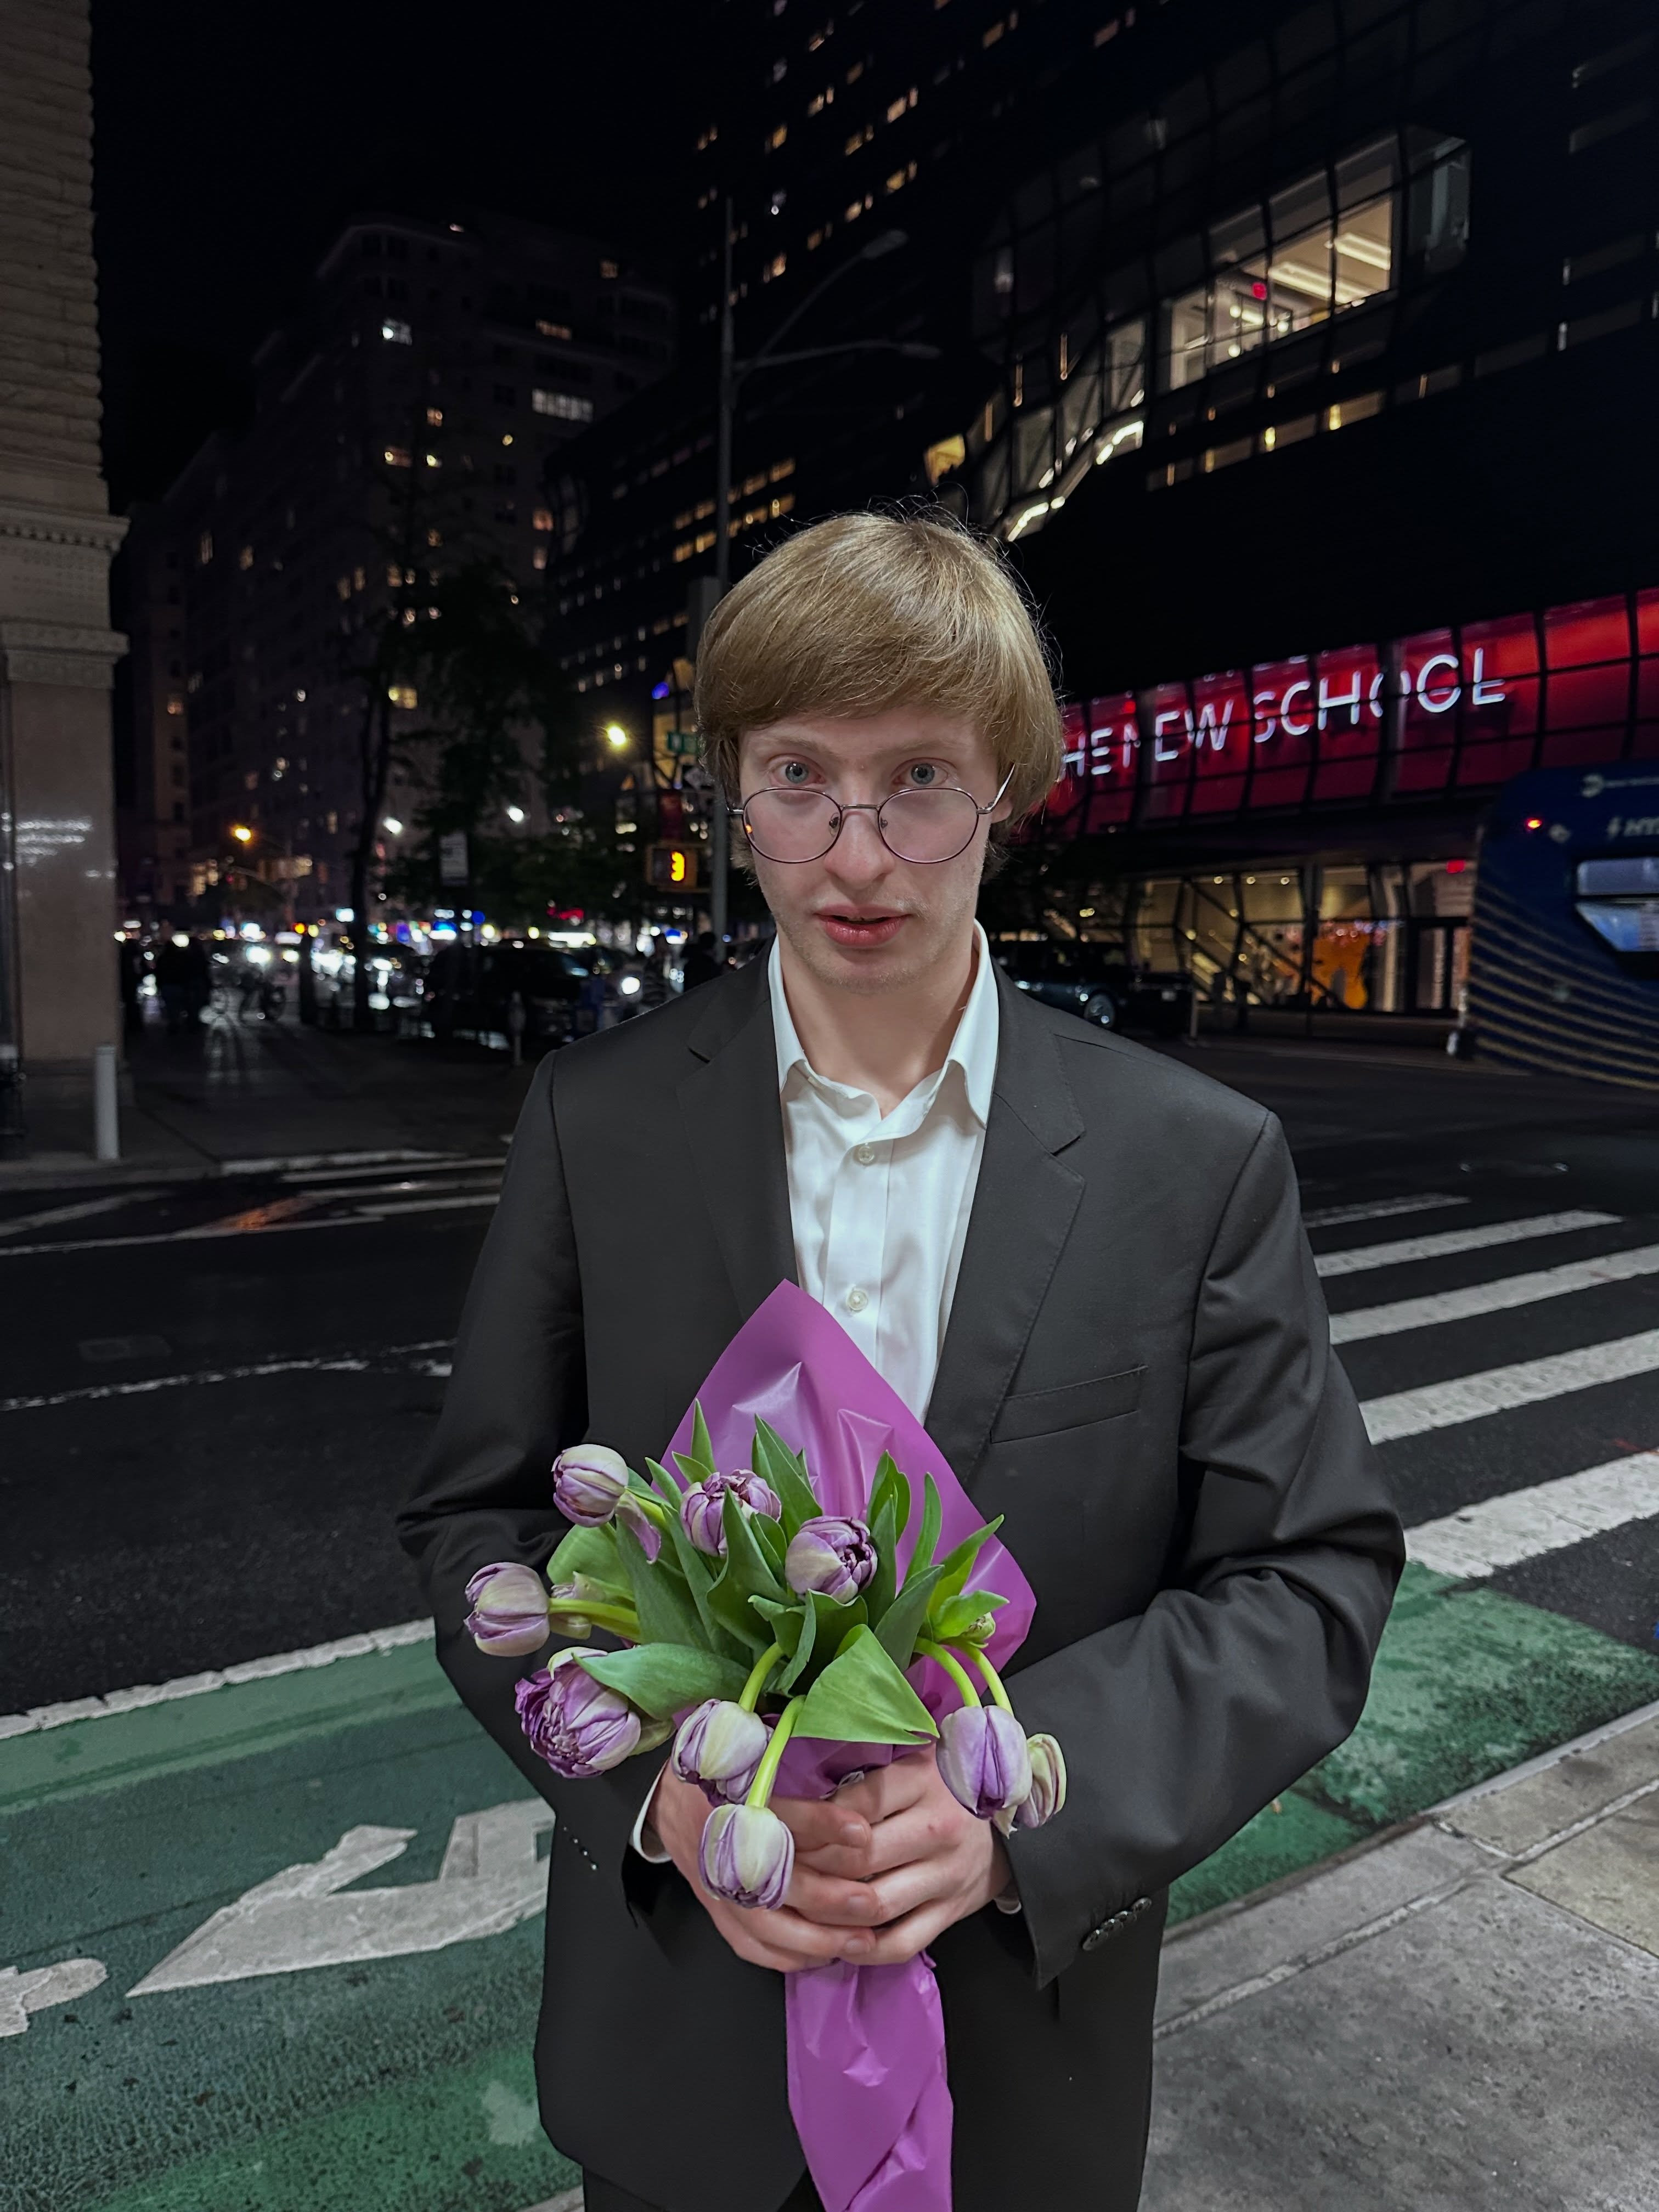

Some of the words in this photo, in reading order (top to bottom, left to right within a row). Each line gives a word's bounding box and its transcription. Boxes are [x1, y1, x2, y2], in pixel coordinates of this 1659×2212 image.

[1058, 727, 1114, 781] HE
[1253, 647, 1506, 743] SCHOOL
[670, 851, 685, 882] 3
